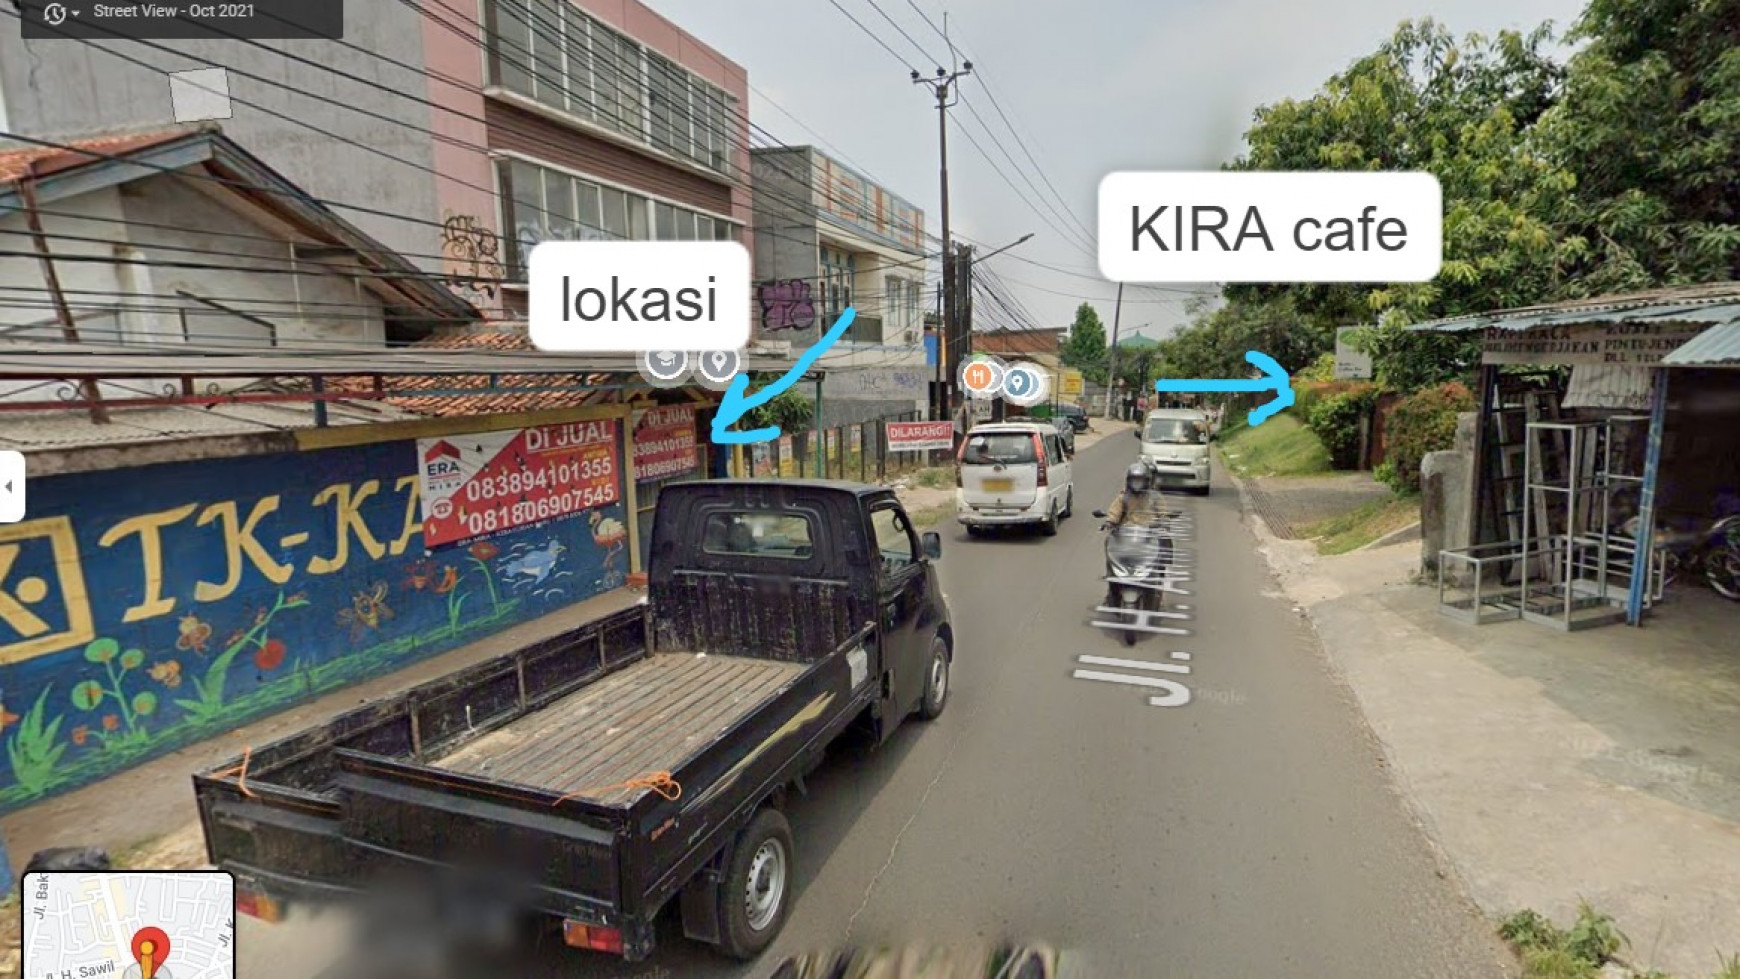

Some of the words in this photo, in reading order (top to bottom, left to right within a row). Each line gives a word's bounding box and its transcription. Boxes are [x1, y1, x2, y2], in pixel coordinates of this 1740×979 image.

[664, 407, 694, 422] JUAL
[557, 420, 613, 446] JUAL
[428, 461, 459, 476] ERA
[467, 456, 612, 502] 083894101355
[469, 483, 614, 534] 081806907545
